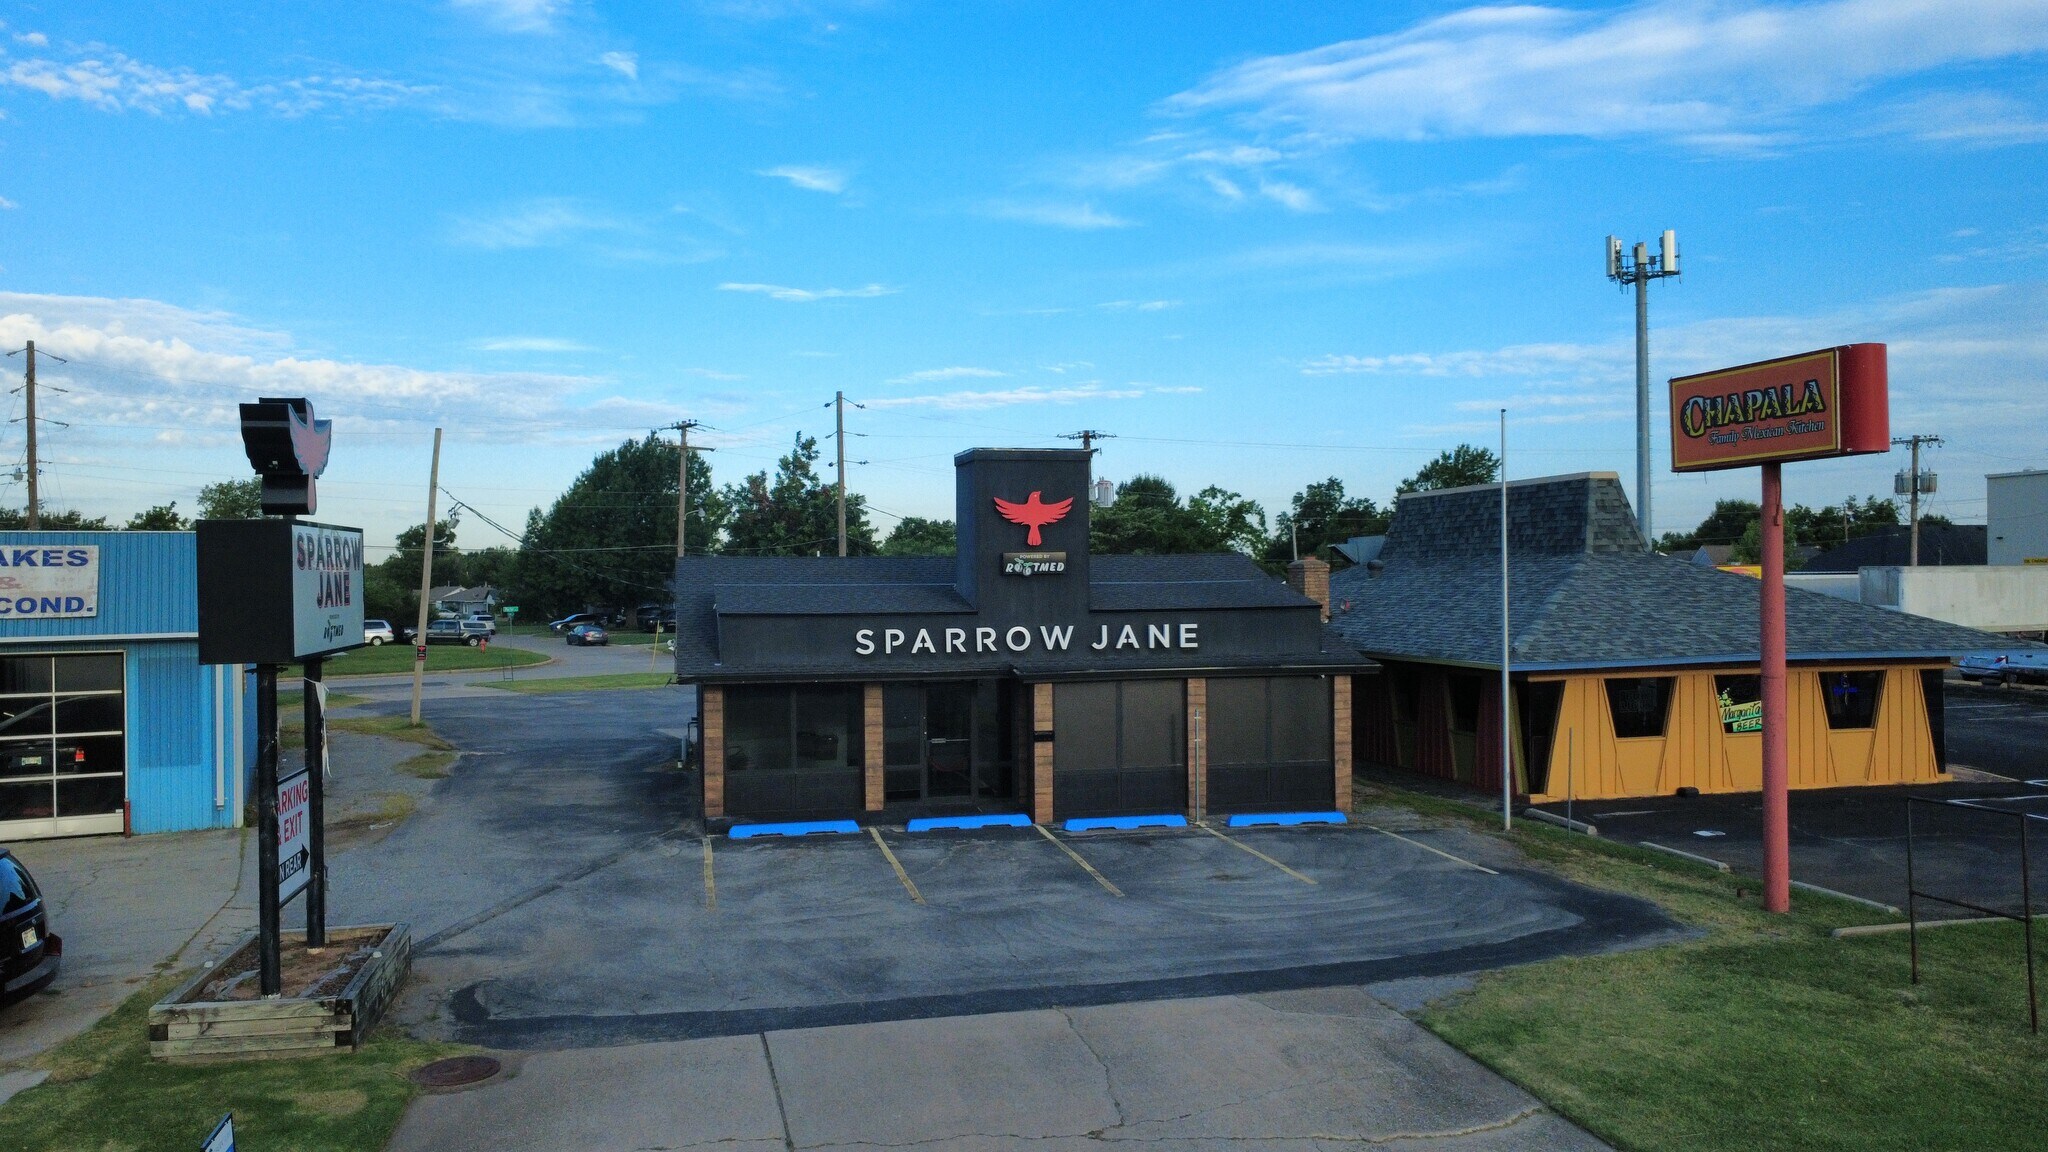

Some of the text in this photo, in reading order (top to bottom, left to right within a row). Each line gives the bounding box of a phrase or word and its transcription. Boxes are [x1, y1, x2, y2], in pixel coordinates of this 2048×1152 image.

[1680, 380, 1826, 438] CHAPALA
[1708, 419, 1825, 447] Family Mexican Kitchen
[297, 532, 361, 571] SPARROW
[317, 571, 351, 609] JANE
[855, 623, 1199, 655] SPARROW JANE
[1737, 718, 1761, 731] BEER
[284, 810, 303, 843] EXIT
[285, 852, 302, 877] REAR
